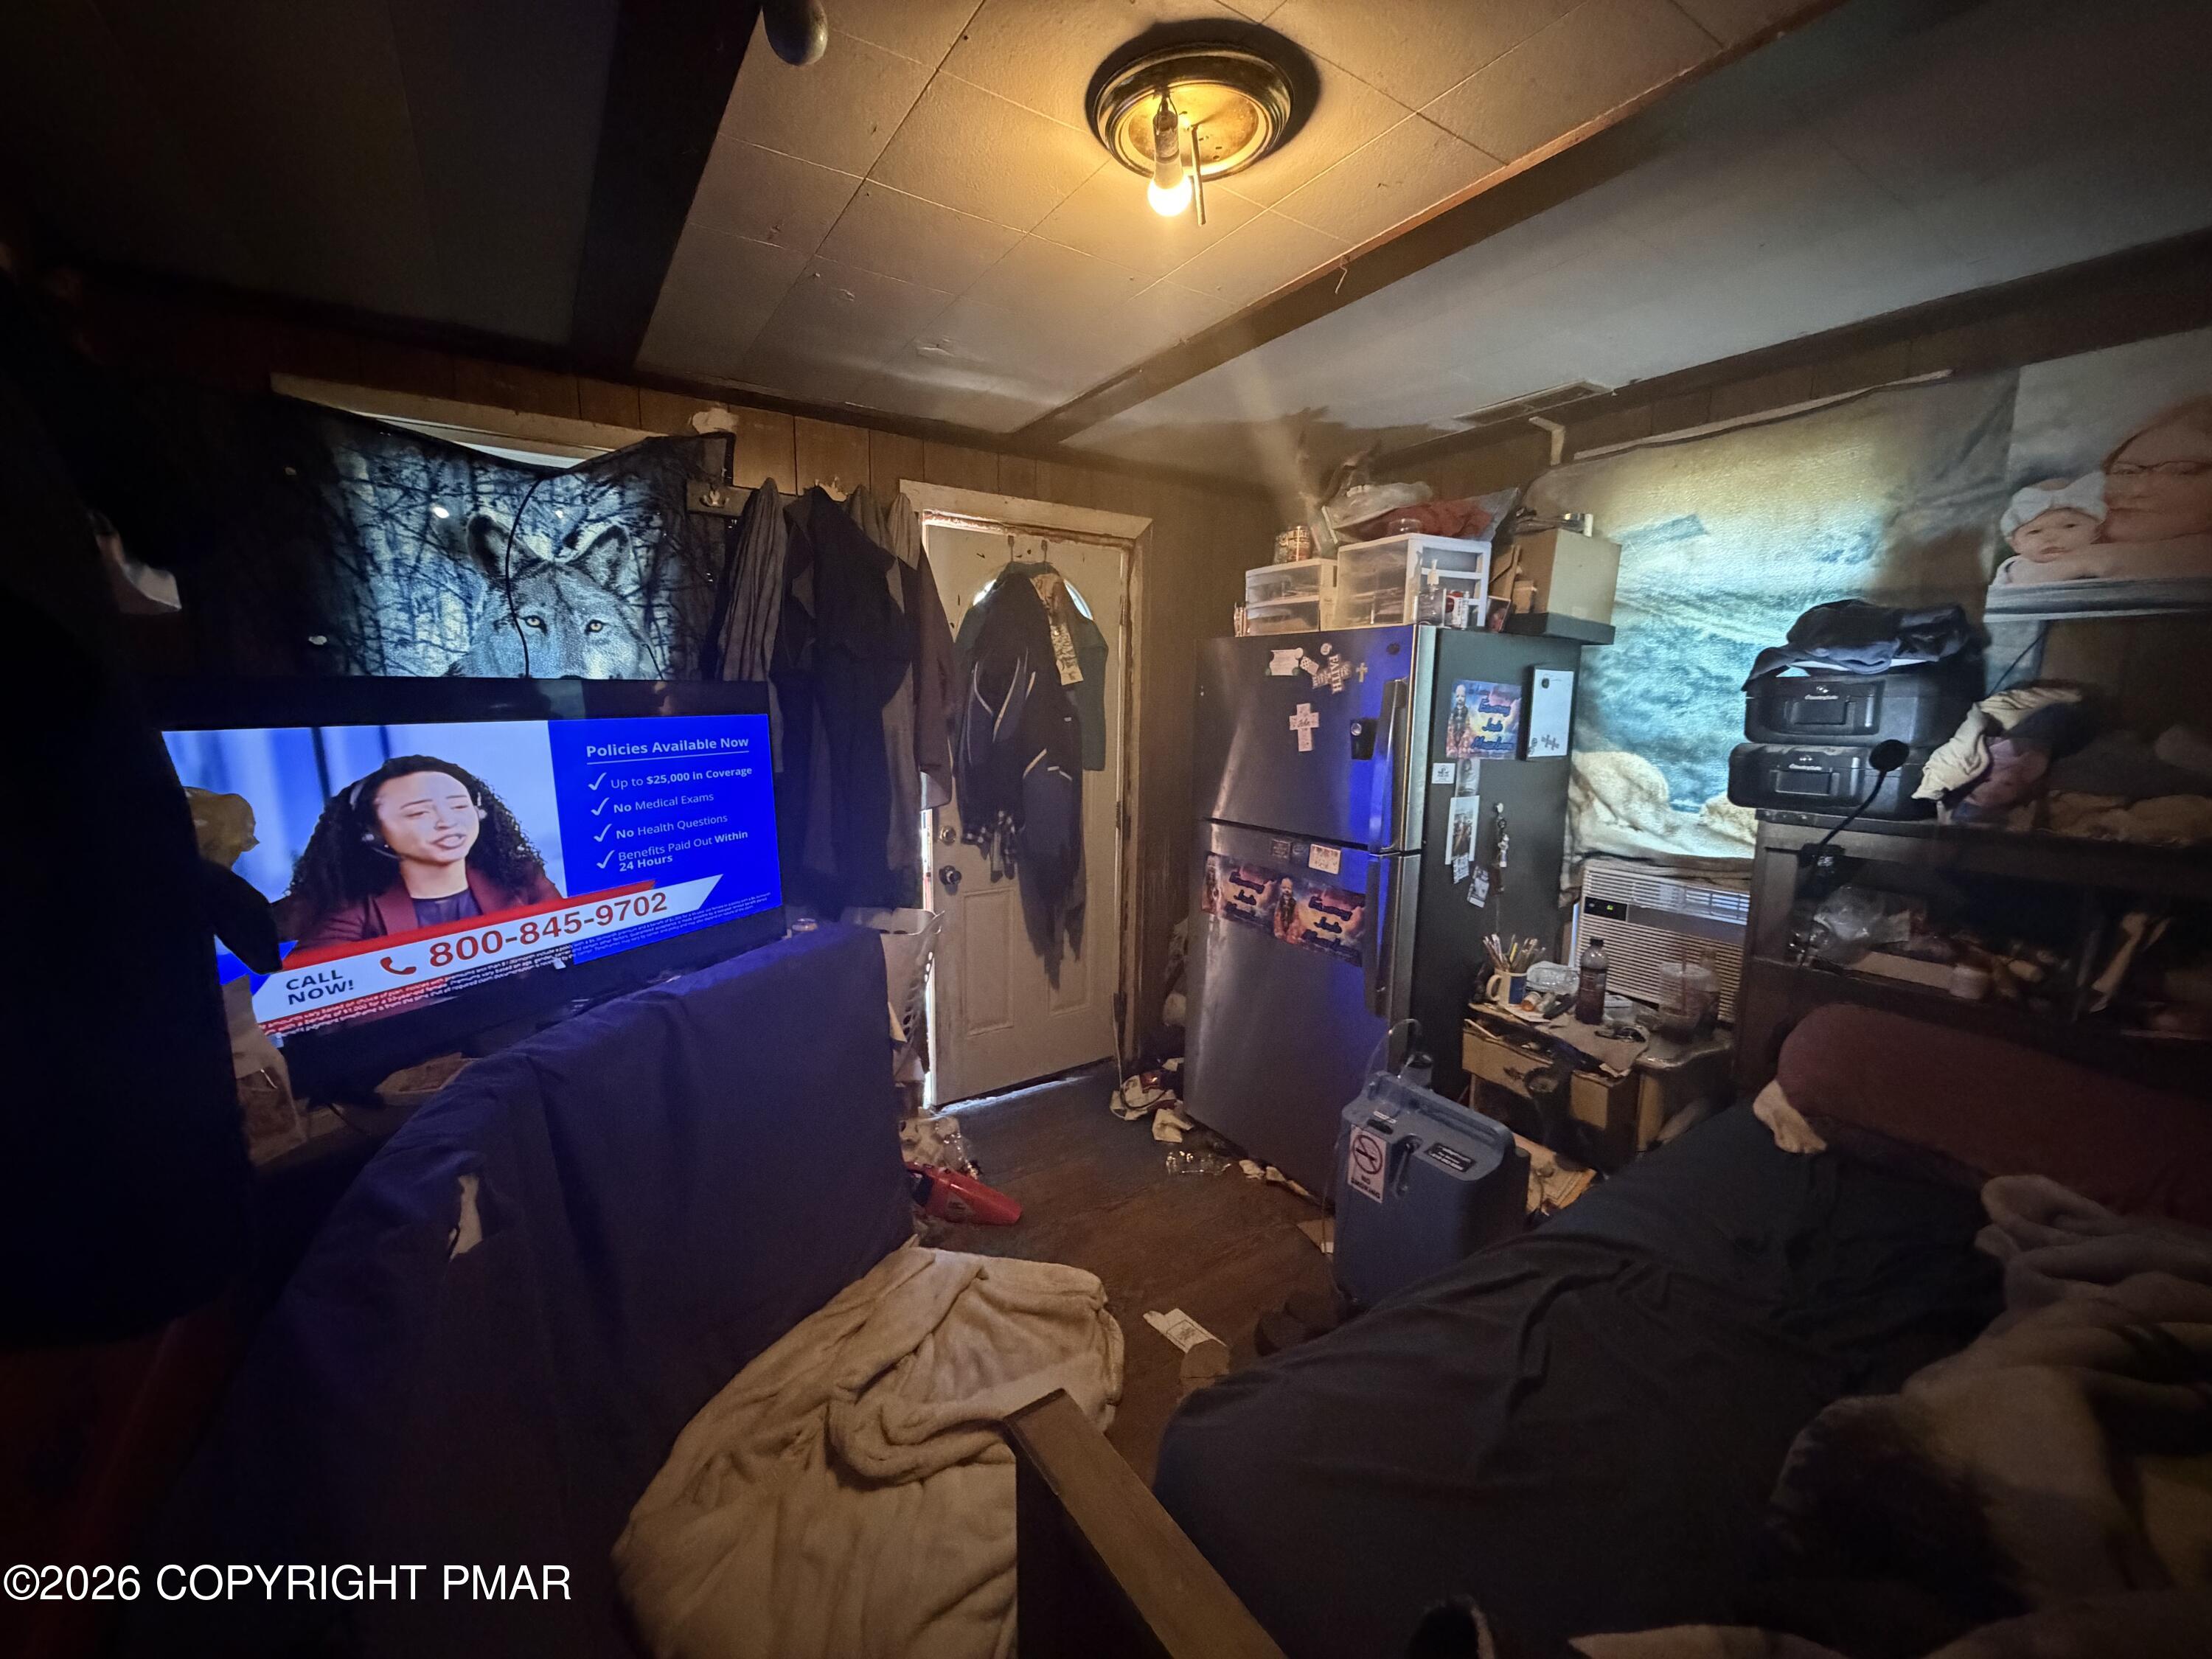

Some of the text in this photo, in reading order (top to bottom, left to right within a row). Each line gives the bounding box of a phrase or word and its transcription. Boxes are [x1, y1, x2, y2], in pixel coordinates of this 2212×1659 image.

[586, 737, 749, 757] Policies Available Now
[611, 767, 753, 790] Up to $25,000 in Coverage
[613, 793, 714, 813] No Medical Exams
[616, 815, 728, 839] No Health Questions
[618, 831, 748, 861] Benefits Paid Out Within
[619, 855, 673, 872] 24 Hours
[430, 892, 667, 967] 800-845-9702
[286, 970, 354, 1005] CALL NOW!
